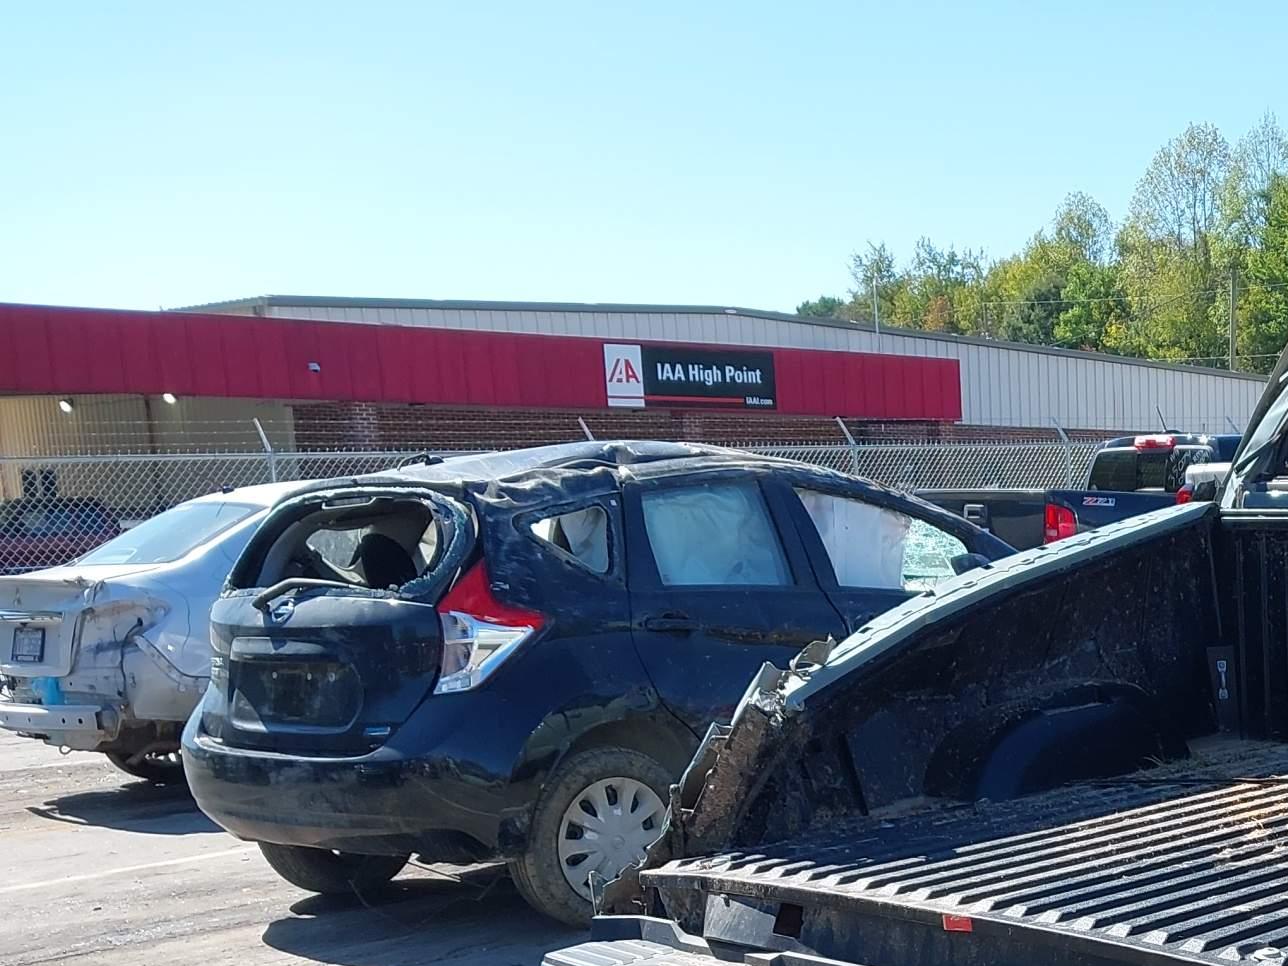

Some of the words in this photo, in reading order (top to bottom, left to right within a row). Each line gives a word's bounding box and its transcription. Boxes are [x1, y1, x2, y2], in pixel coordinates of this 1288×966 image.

[656, 362, 686, 381] IAA
[688, 364, 721, 386] High
[725, 365, 762, 384] Point
